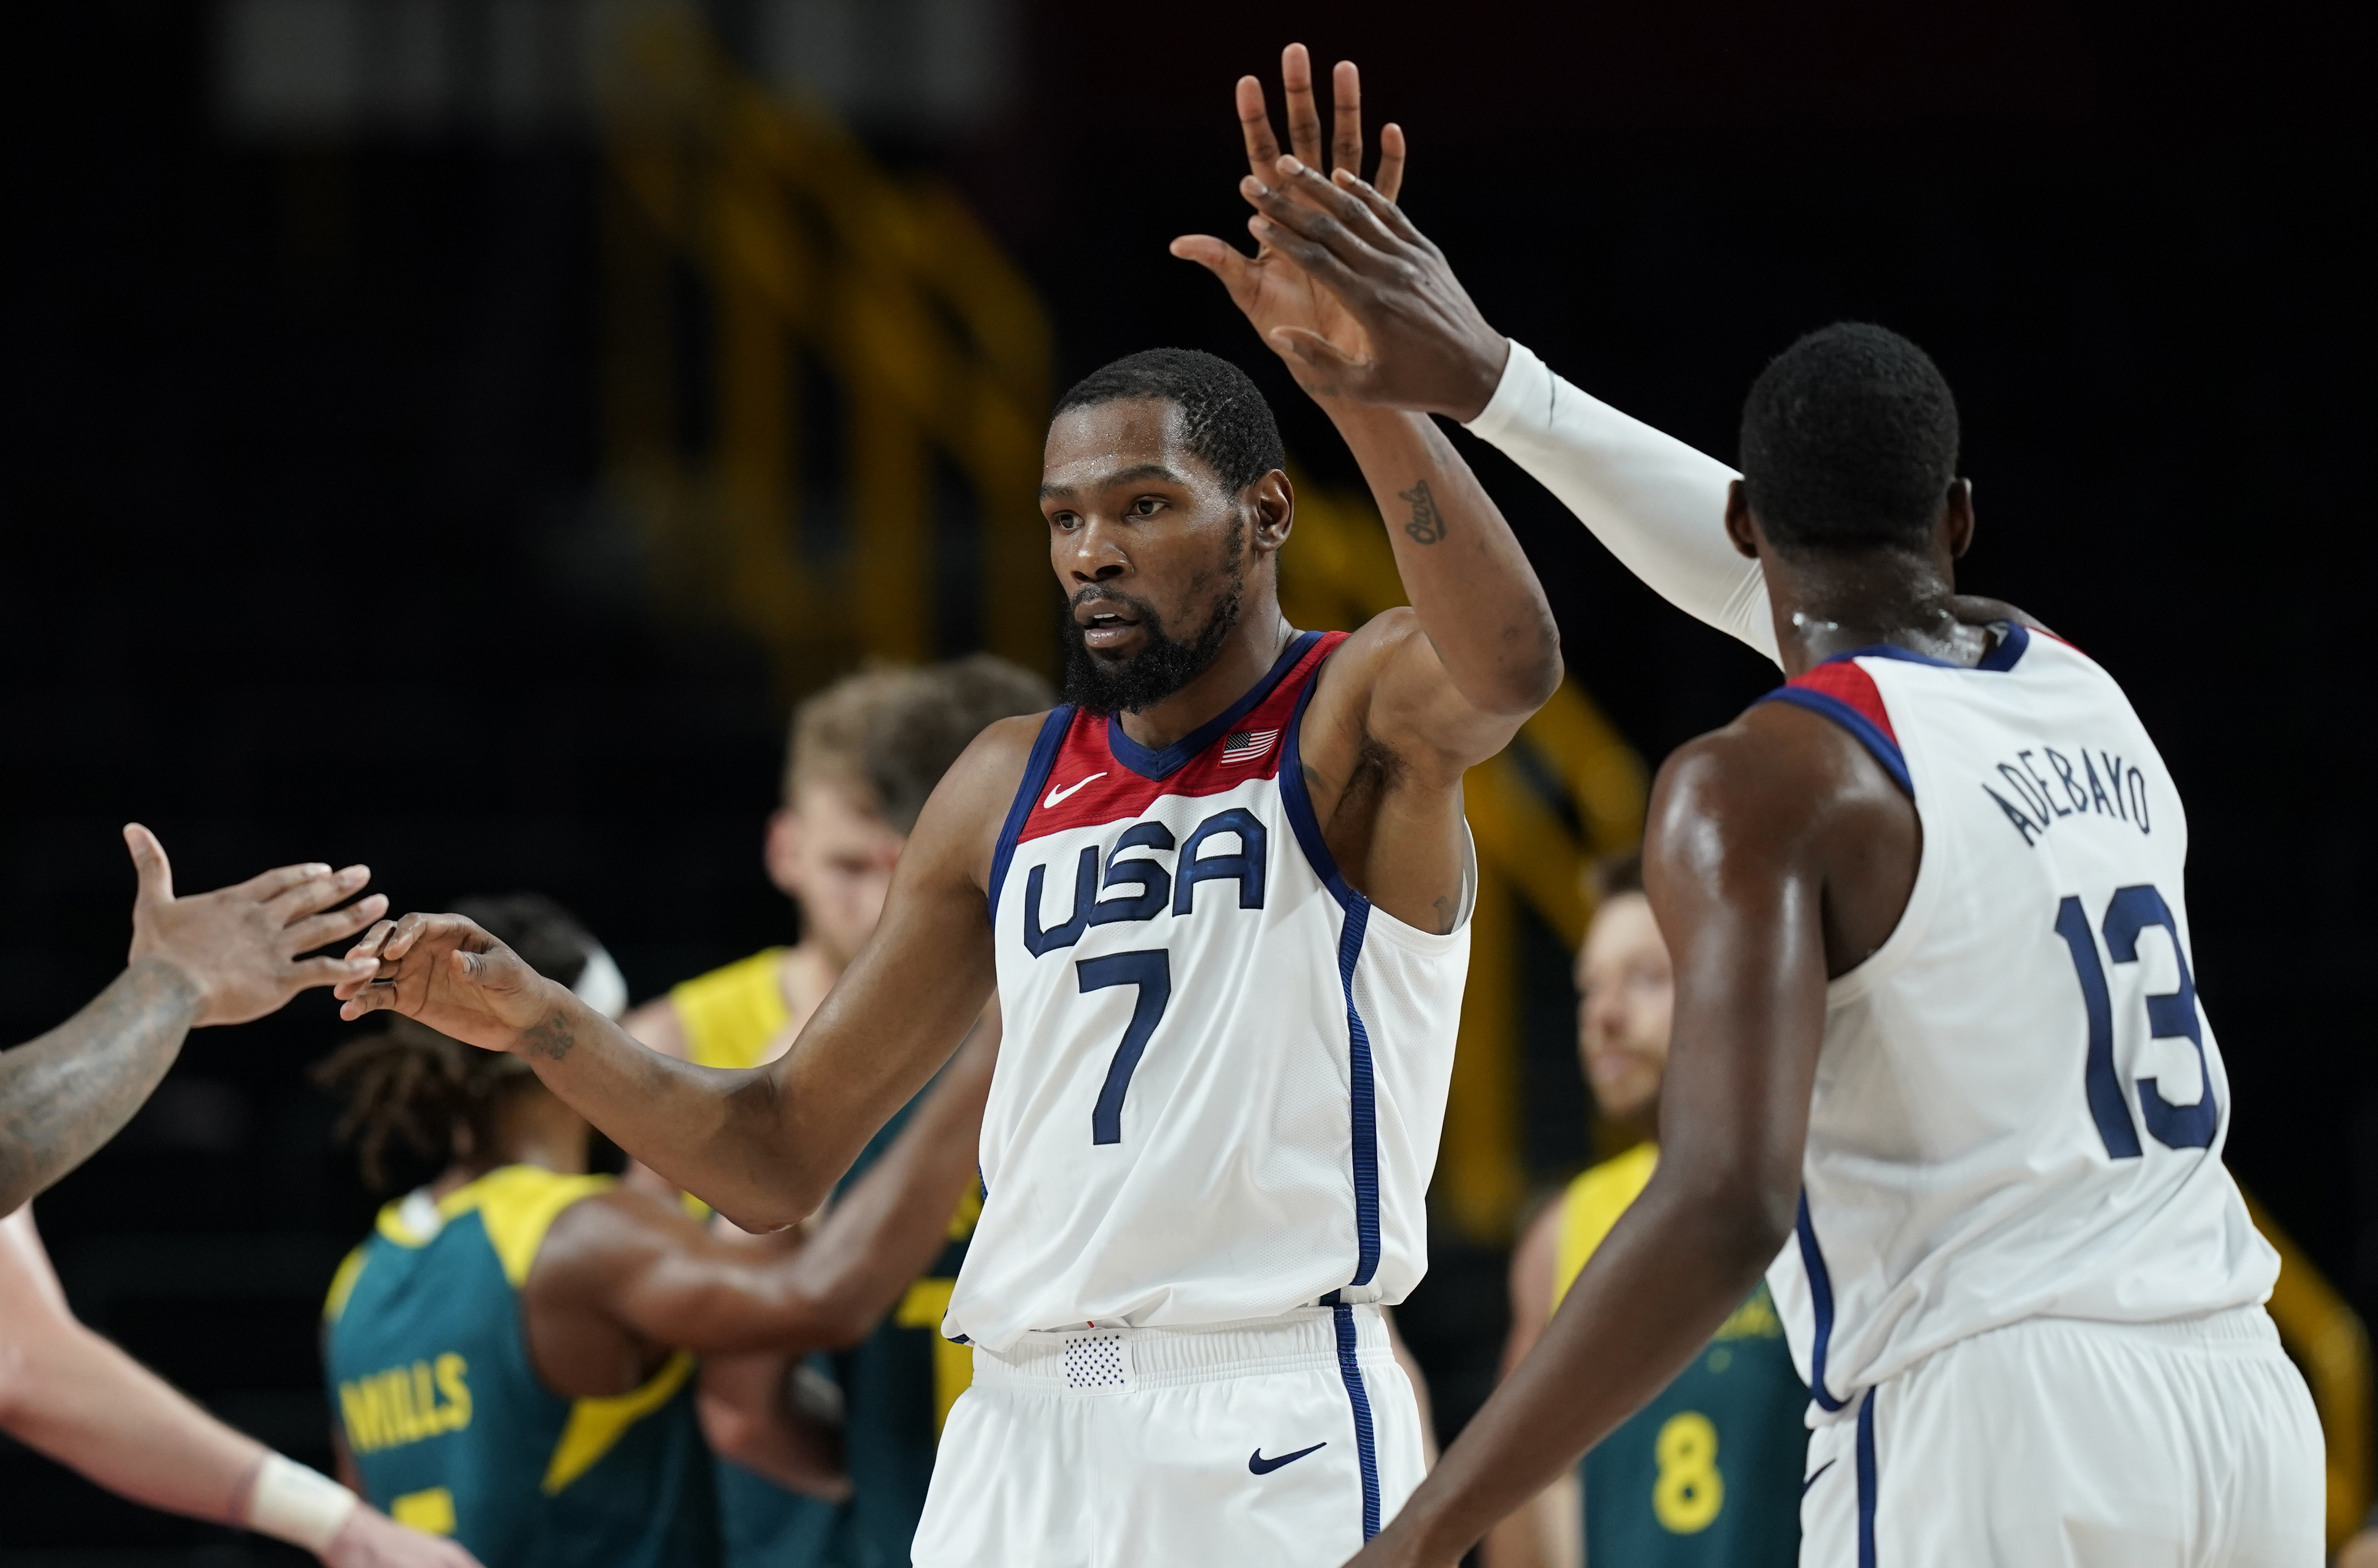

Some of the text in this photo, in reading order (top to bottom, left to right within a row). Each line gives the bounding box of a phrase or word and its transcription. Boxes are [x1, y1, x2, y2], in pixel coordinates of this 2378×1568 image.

[1982, 747, 2150, 847] ADEBAYO
[1024, 807, 1267, 959] USA
[1075, 948, 1171, 1145] 7
[2055, 884, 2216, 1160] 13
[1652, 1411, 1724, 1535] 8
